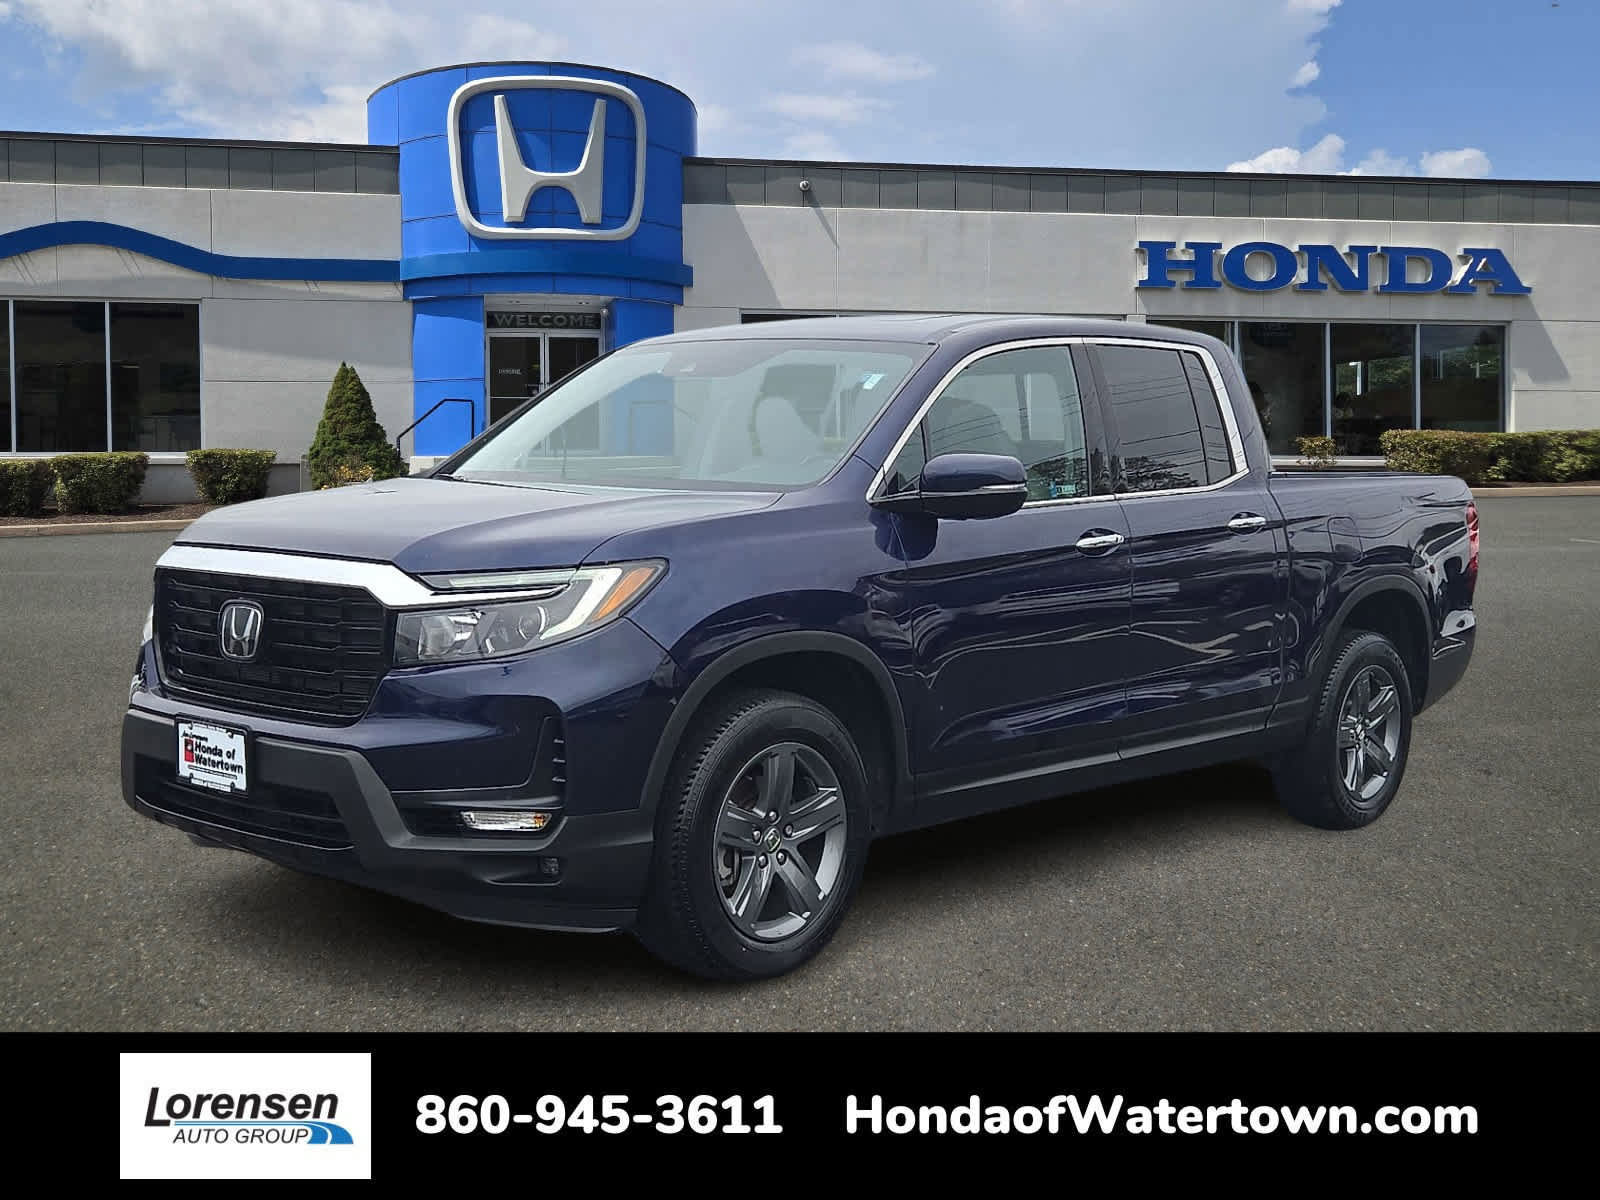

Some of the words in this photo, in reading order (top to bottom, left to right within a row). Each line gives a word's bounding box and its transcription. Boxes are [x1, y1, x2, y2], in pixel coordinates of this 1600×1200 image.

[1137, 241, 1532, 295] HONDA
[494, 313, 597, 327] WELCOME
[195, 740, 223, 758] Honda
[226, 748, 236, 760] of
[194, 753, 244, 774] Watertown
